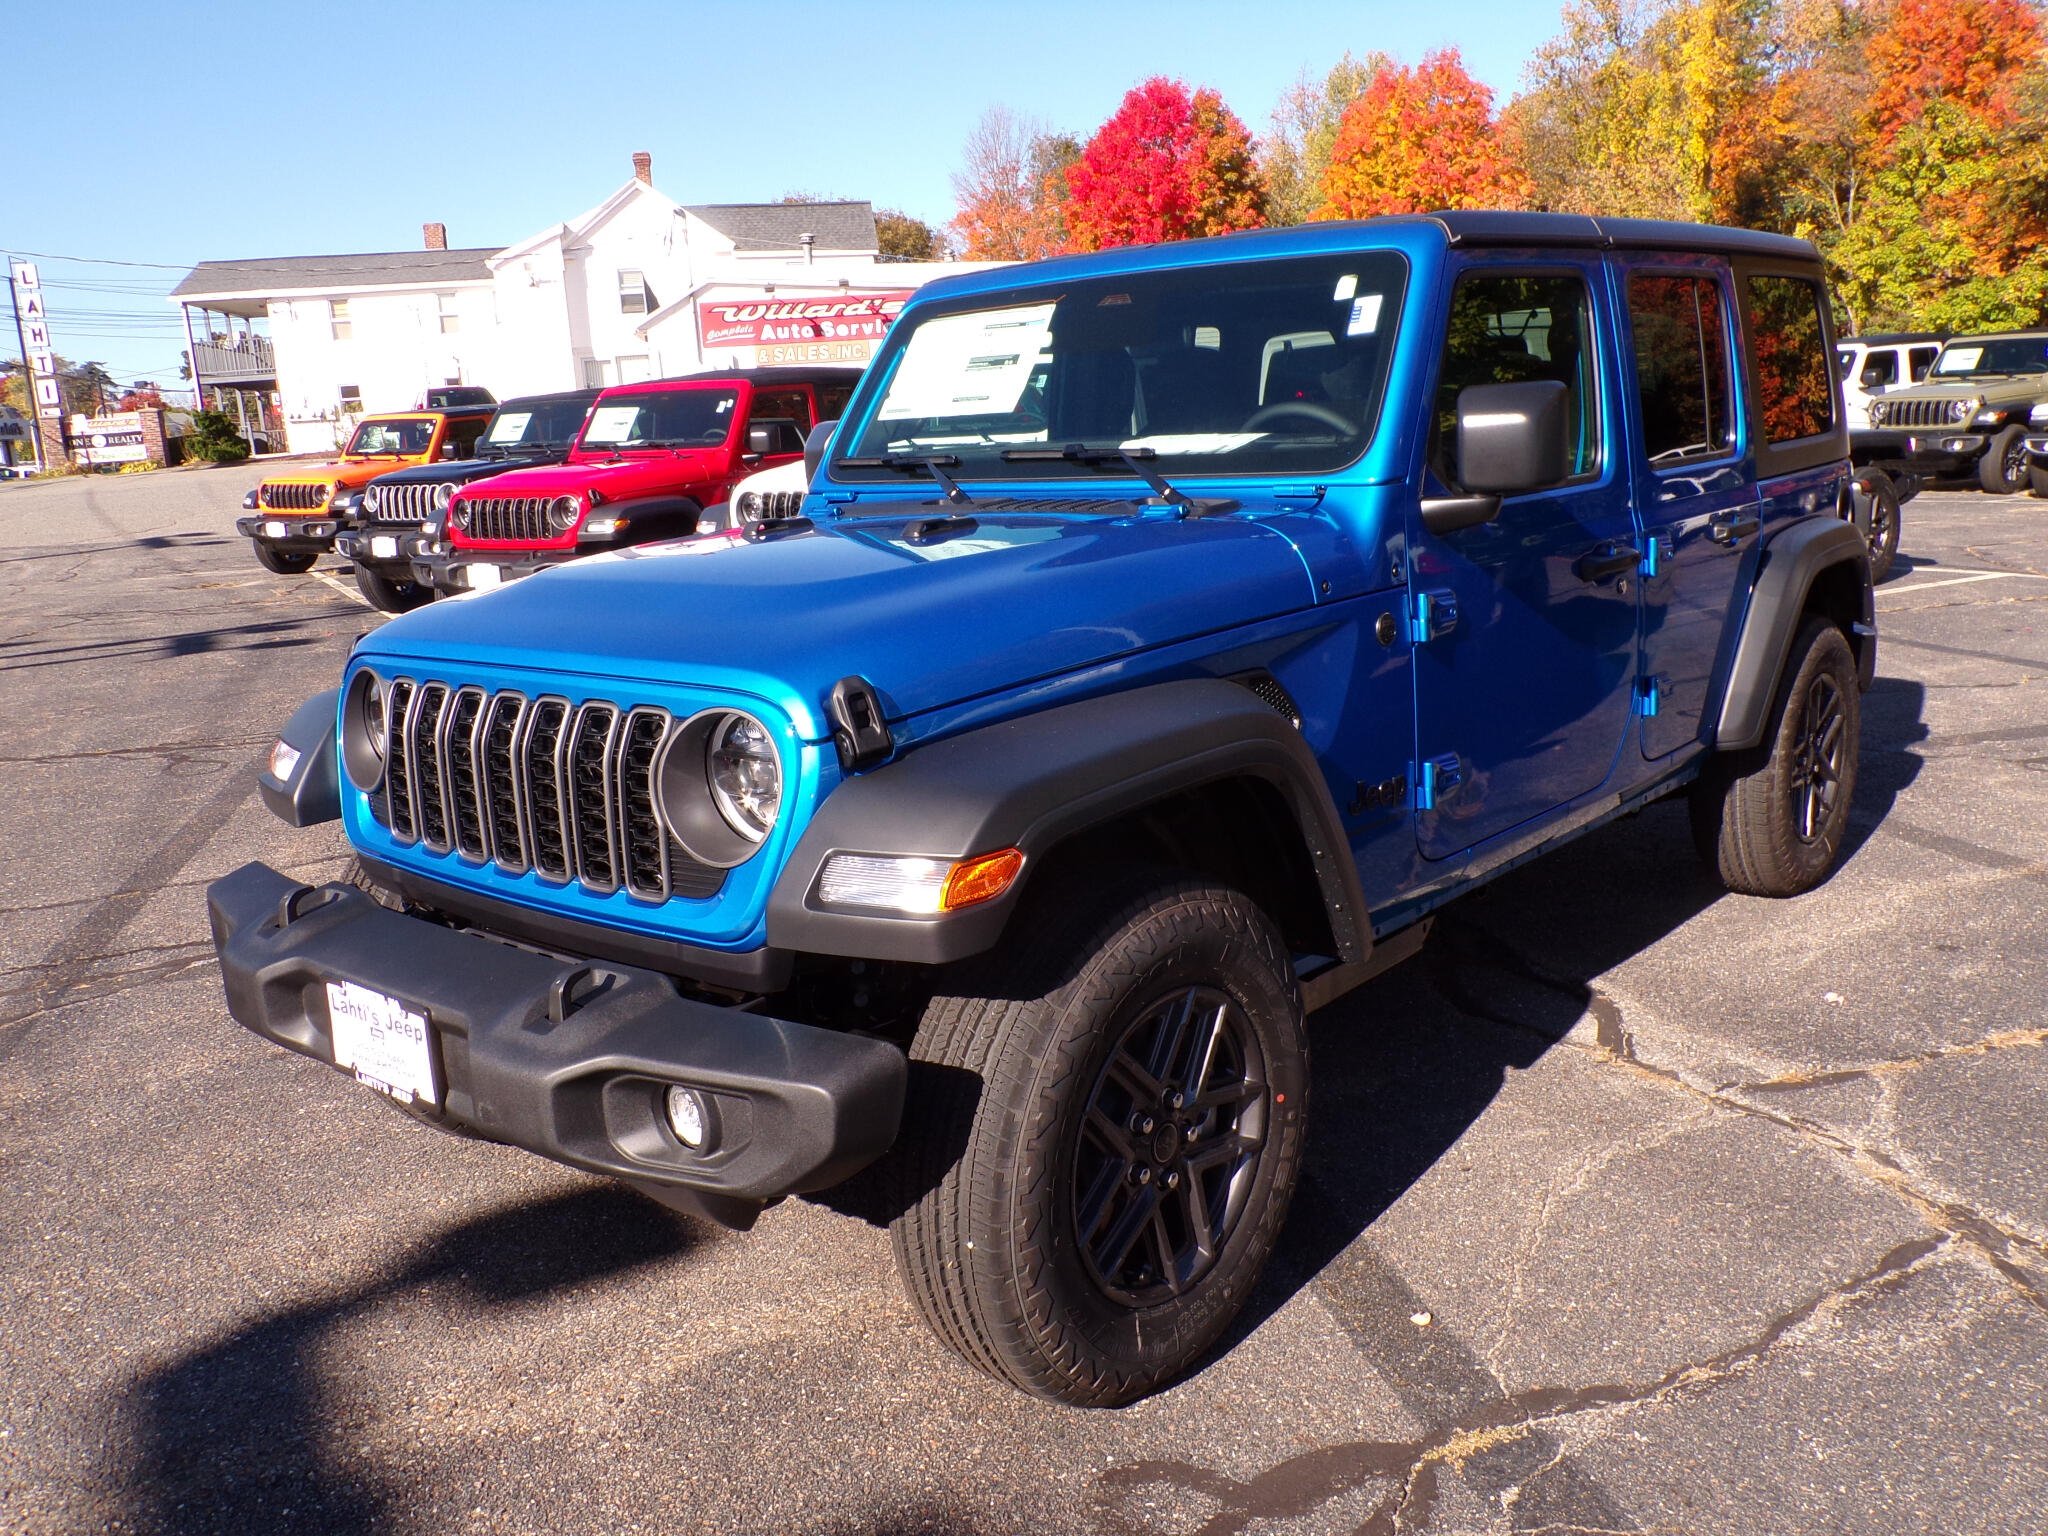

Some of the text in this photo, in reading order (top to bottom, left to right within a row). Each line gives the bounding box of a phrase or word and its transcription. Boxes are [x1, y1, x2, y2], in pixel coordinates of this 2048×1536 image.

[708, 297, 906, 323] Willard's
[760, 322, 815, 340] Auto
[107, 434, 143, 444] REALTY
[1349, 773, 1407, 816] Jeep
[331, 992, 423, 1046] Lahti's Jeep
